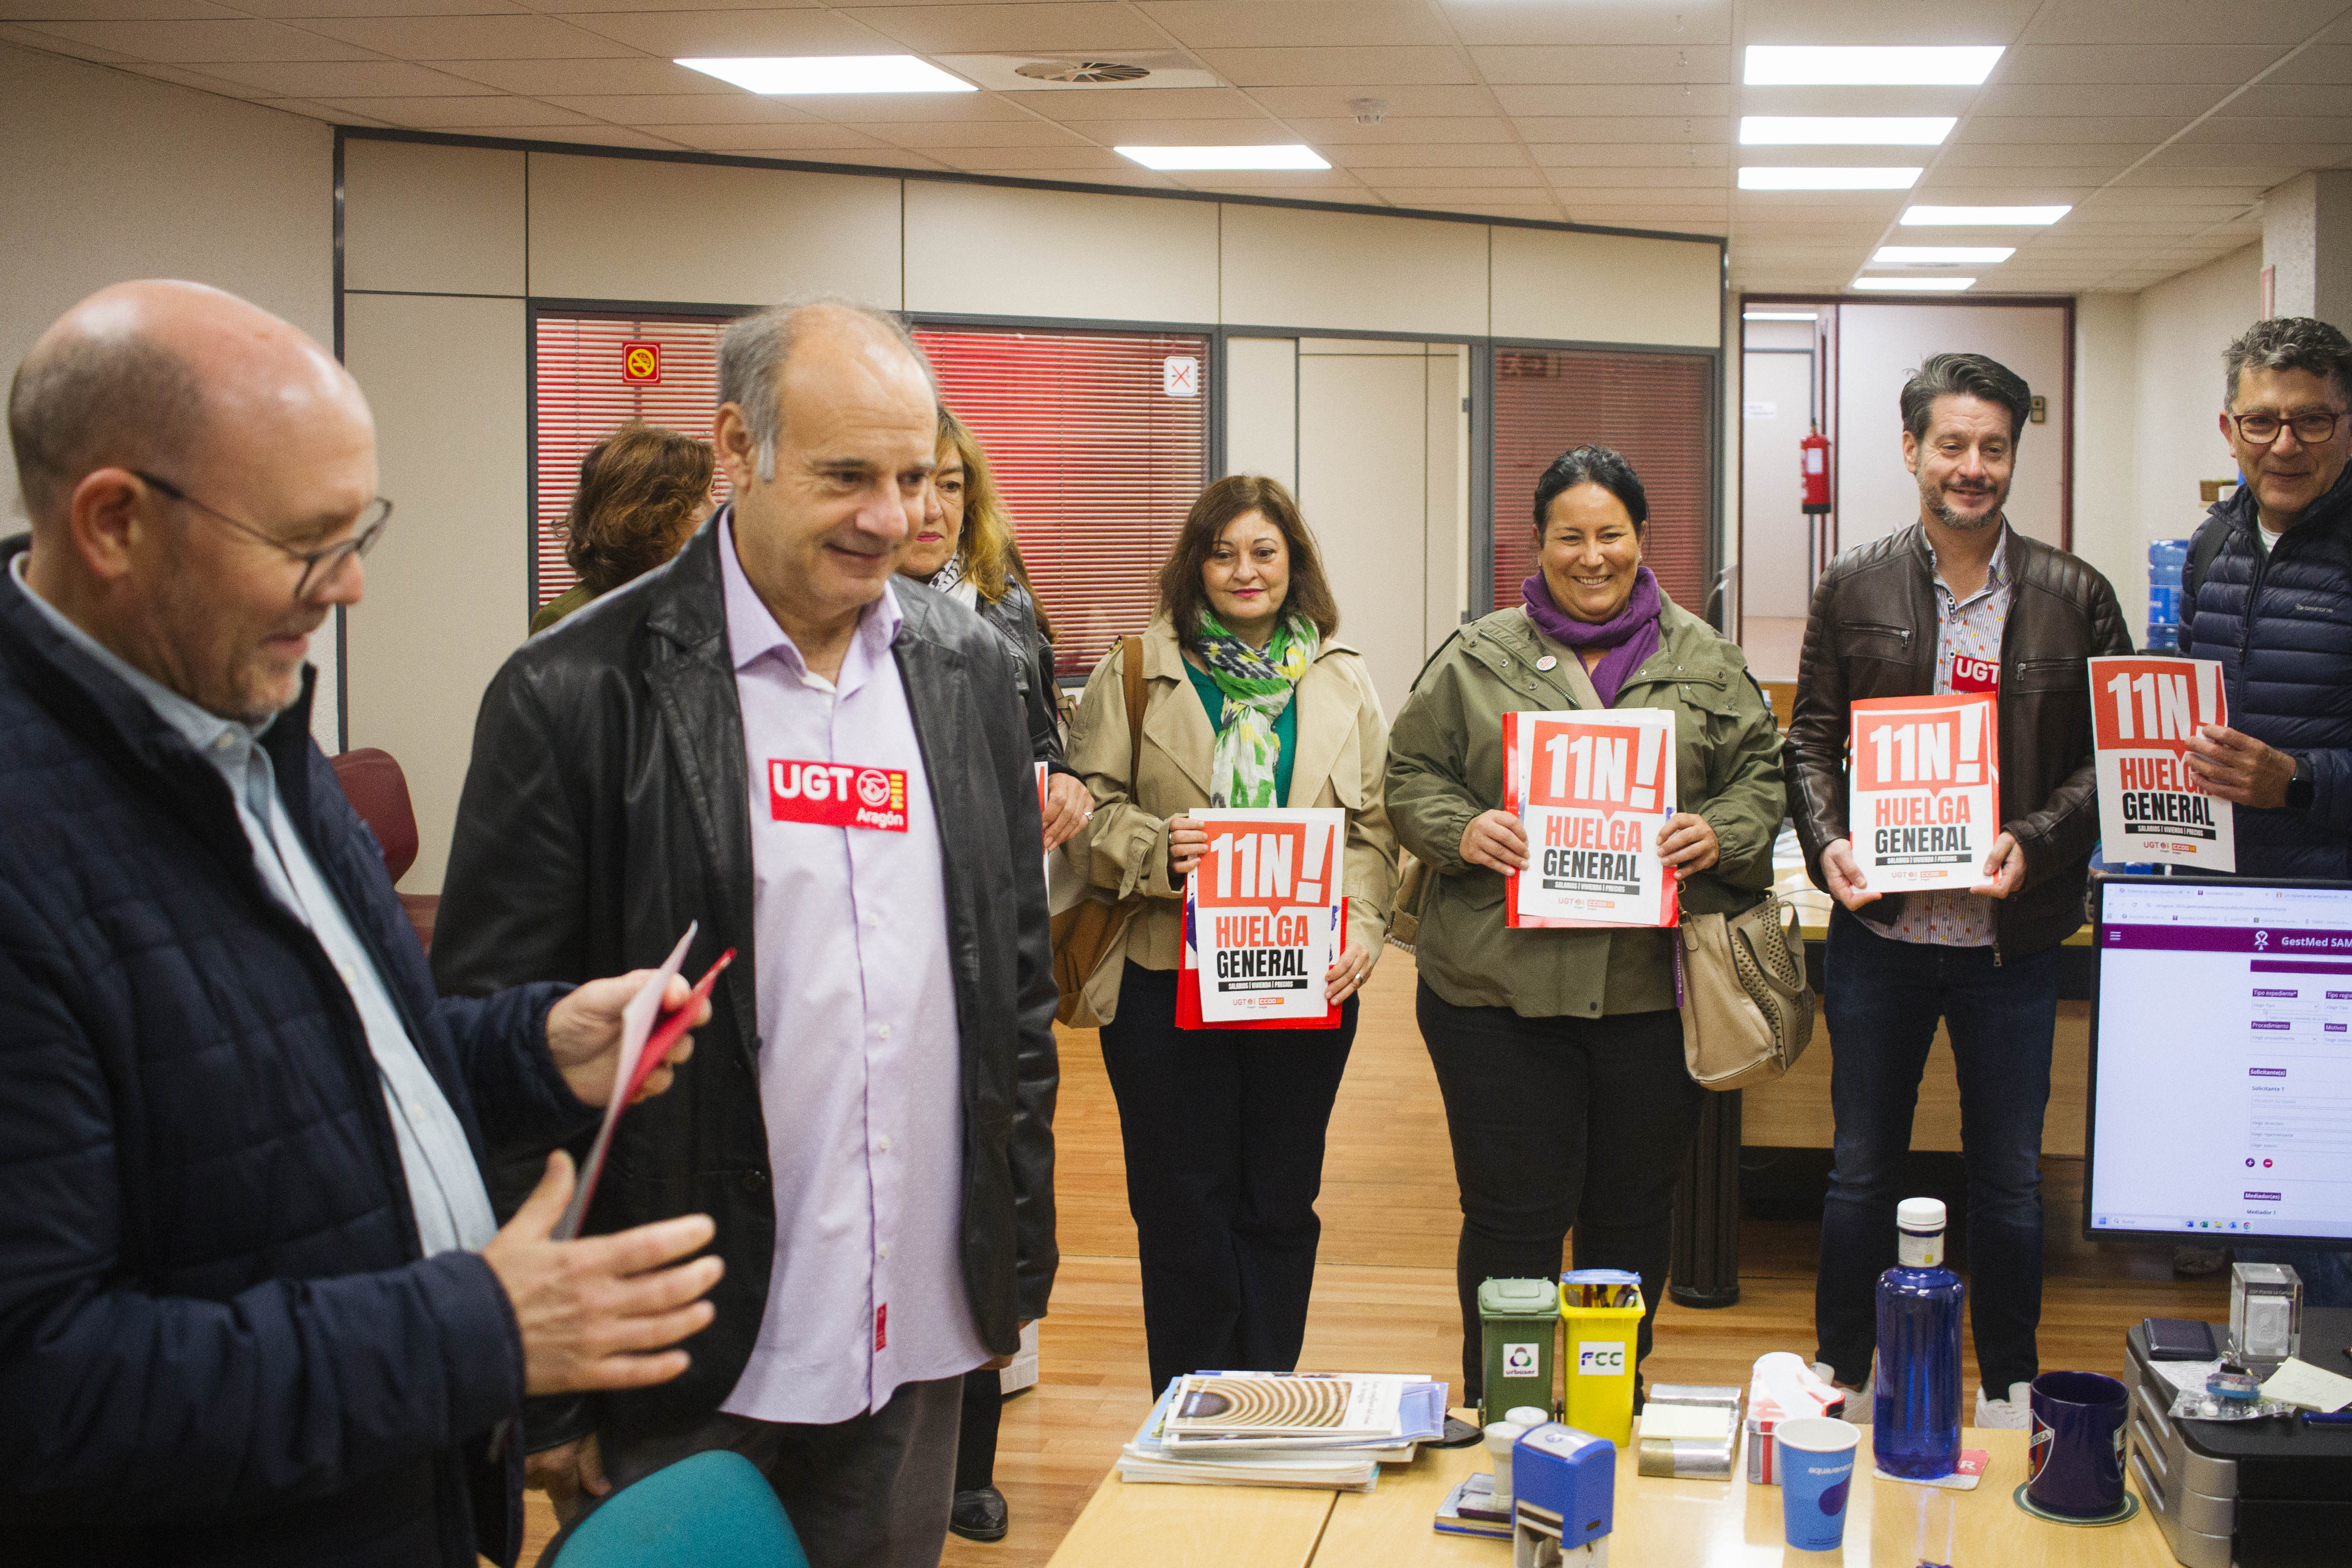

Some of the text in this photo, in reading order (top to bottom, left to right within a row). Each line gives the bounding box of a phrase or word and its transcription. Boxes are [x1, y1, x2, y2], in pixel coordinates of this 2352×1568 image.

[1956, 657, 2000, 684] UGT
[2107, 663, 2219, 740] 11N!
[1870, 706, 1983, 783] 11N!
[772, 762, 853, 801] UGT
[1545, 725, 1665, 809] 11N!
[2120, 758, 2212, 796] HUELG
[856, 808, 904, 828] Aragón
[1876, 795, 1971, 827] HUELGA
[2123, 792, 2215, 826] GENERAL
[1545, 815, 1642, 853] HUELGA
[1875, 826, 1971, 854] GENERAL
[1210, 823, 1330, 903] 11N!
[1543, 849, 1640, 882] GENERAL
[1554, 881, 1578, 889] SALARIOS
[1216, 915, 1308, 948] HUELGA
[2281, 936, 2328, 946] GestMed
[1216, 949, 1308, 978] GENERAL
[1581, 1352, 1622, 1366] FCC
